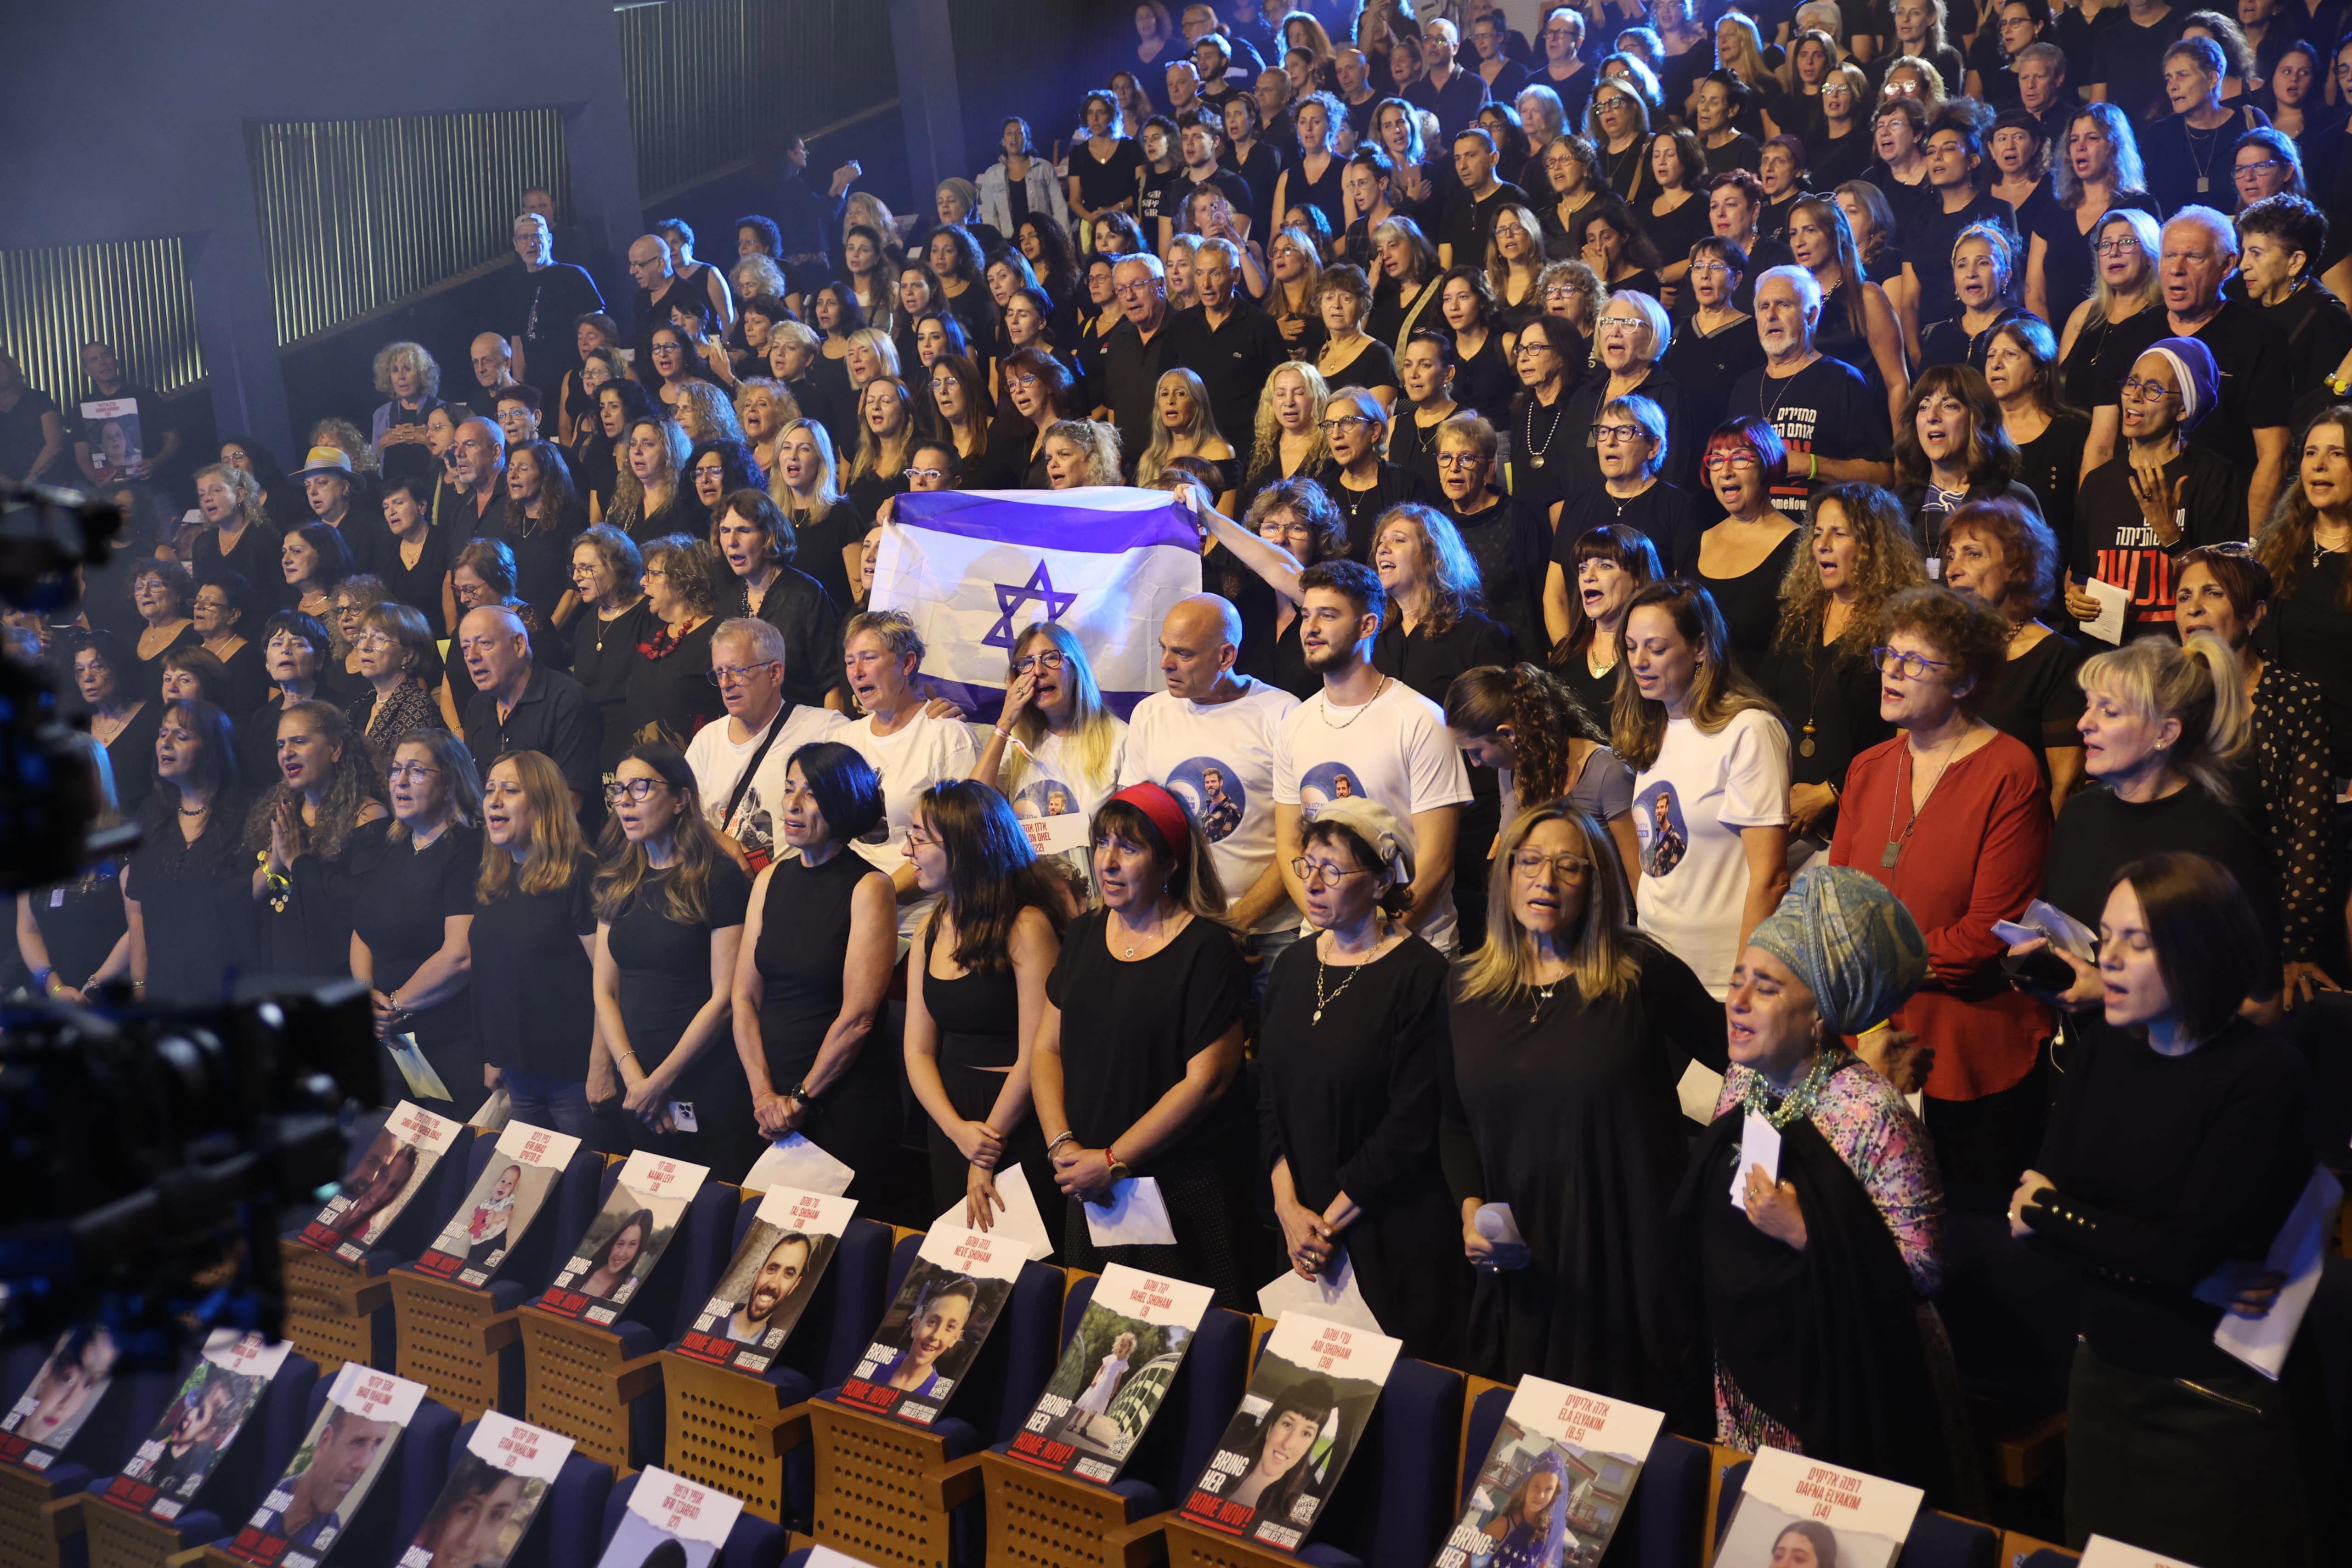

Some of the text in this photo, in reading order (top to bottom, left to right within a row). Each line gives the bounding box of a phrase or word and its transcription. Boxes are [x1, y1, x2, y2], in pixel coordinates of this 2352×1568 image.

[1777, 407, 1817, 423] מחזירים
[1787, 423, 1814, 440] אותם
[1034, 822, 1047, 832] אלון
[1037, 832, 1051, 842] OHEL
[662, 1173, 675, 1184] LEVY
[327, 1194, 352, 1213] BRING
[790, 1206, 820, 1220] TAL SHOHAM
[316, 1207, 339, 1226] THEM
[441, 1221, 468, 1239] BRING
[430, 1234, 451, 1251] HIM
[954, 1245, 991, 1263] NEVE SHOHAM
[564, 1256, 592, 1275] BRING
[962, 1259, 972, 1272] (8)
[553, 1271, 574, 1288] HER
[541, 1287, 569, 1306] HOME
[560, 1293, 591, 1312] NOW!
[703, 1297, 735, 1318] BRING
[1130, 1289, 1172, 1309] YAHEL SHOHAM
[1139, 1305, 1150, 1319] (3)
[693, 1313, 716, 1332] HIM
[681, 1331, 711, 1351] HOME
[705, 1338, 737, 1359] NOW!
[1323, 1327, 1352, 1344] עדי שהם
[865, 1342, 898, 1365] BRING
[1311, 1339, 1352, 1360] ADI SHOHAM
[853, 1359, 878, 1380] HIM
[1318, 1355, 1333, 1370] (38)
[842, 1378, 873, 1400] HOME
[867, 1386, 901, 1408] NOW!
[1037, 1393, 1073, 1417] BRING
[1565, 1394, 1610, 1417] אלה אליקים
[1025, 1411, 1051, 1433] HER
[1558, 1407, 1605, 1431] ELA ELYAKIM
[1565, 1425, 1585, 1443] (8.5)
[1012, 1431, 1077, 1464] HOME NOW!
[1210, 1449, 1250, 1477] BRING
[1199, 1469, 1227, 1494] HER
[1807, 1466, 1862, 1494] דפנה אליקים
[1796, 1480, 1862, 1511] DAFNA ELYAKIM
[1186, 1490, 1257, 1528] HOME NOW!
[1812, 1502, 1832, 1521] (14)
[1255, 1527, 1299, 1548] FAMILIES FORUM
[1448, 1525, 1492, 1556] BRING
[1435, 1546, 1467, 1568] HER
